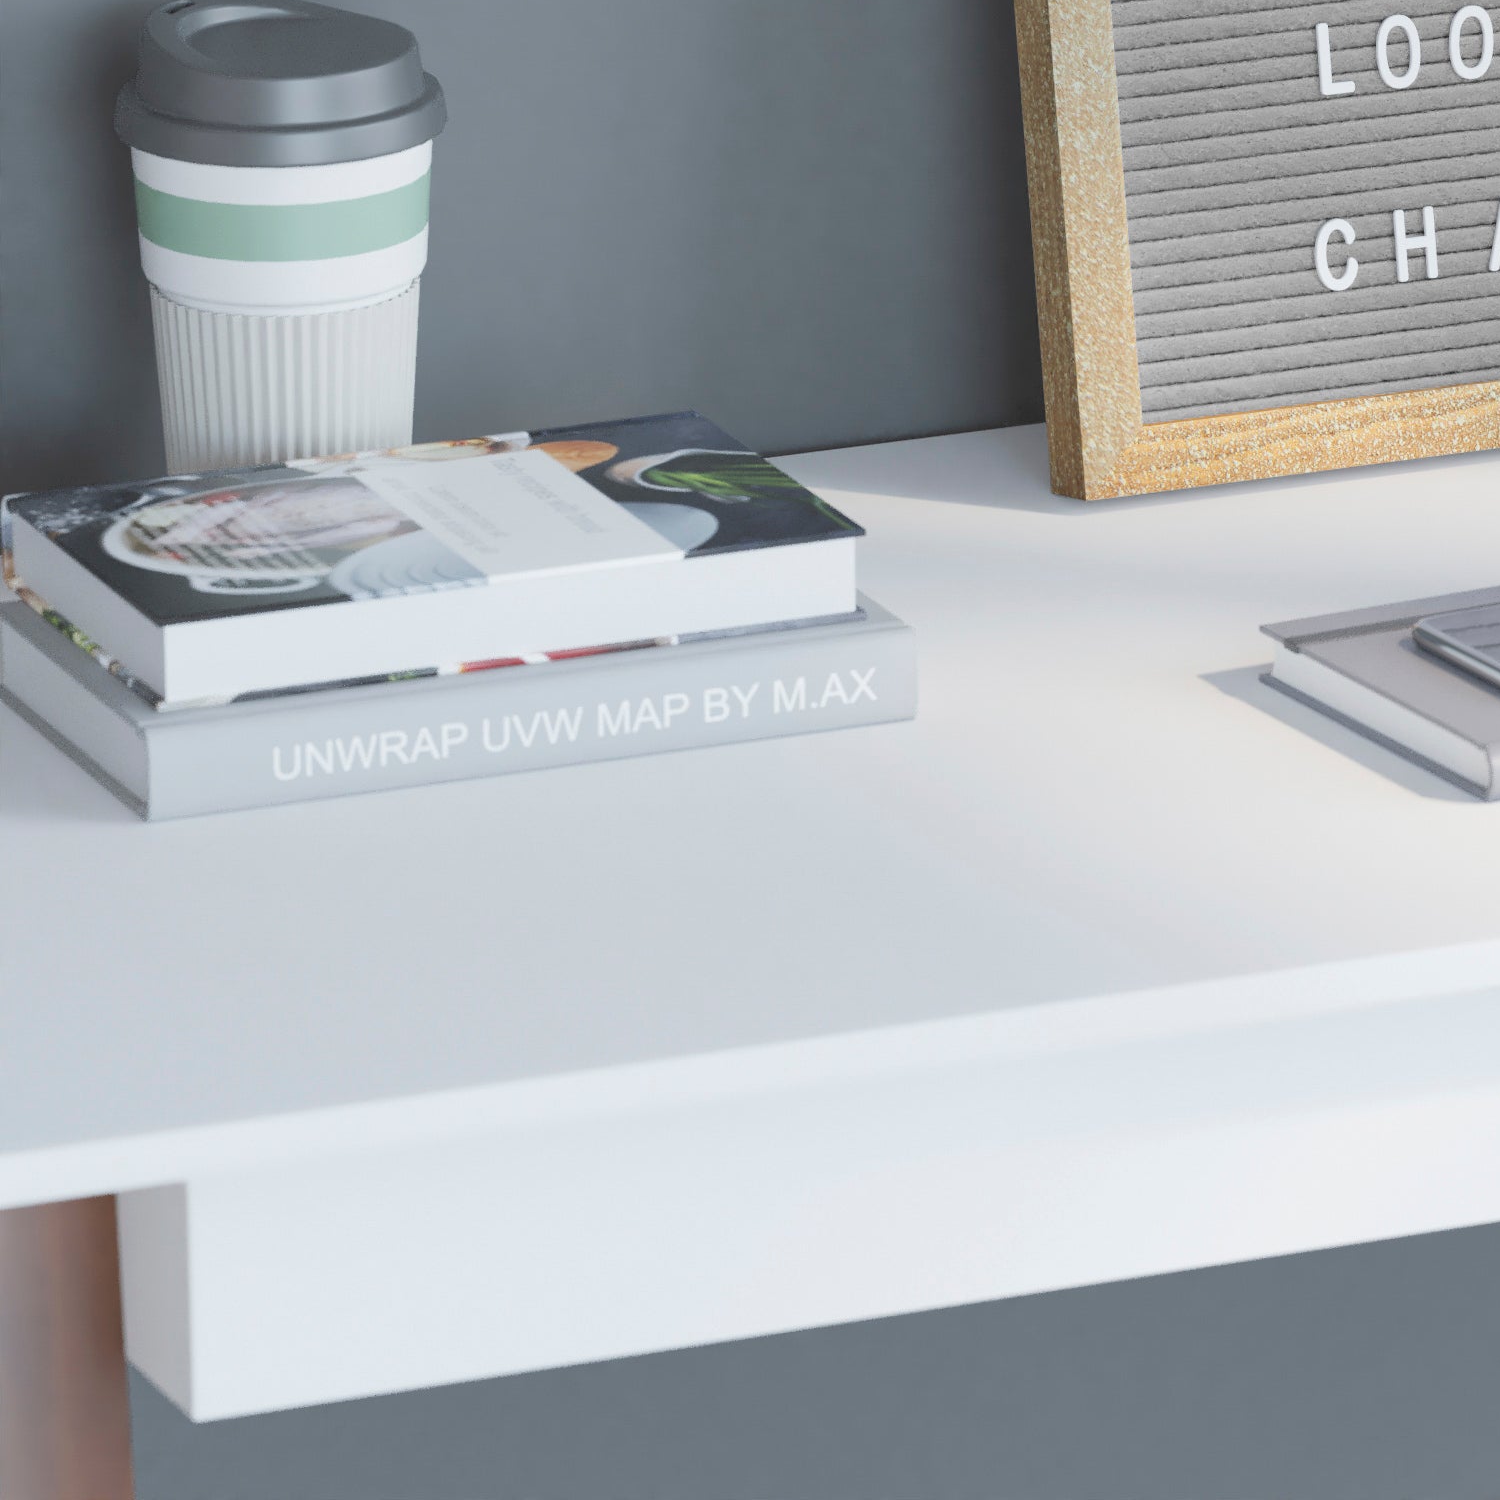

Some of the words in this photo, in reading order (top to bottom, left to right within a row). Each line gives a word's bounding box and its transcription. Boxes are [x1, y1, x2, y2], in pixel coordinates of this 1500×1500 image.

[271, 722, 470, 782] UNWRAP
[481, 706, 585, 754] UVW
[596, 691, 691, 738] MAP
[701, 680, 762, 724] BY
[772, 667, 880, 715] M.AX
